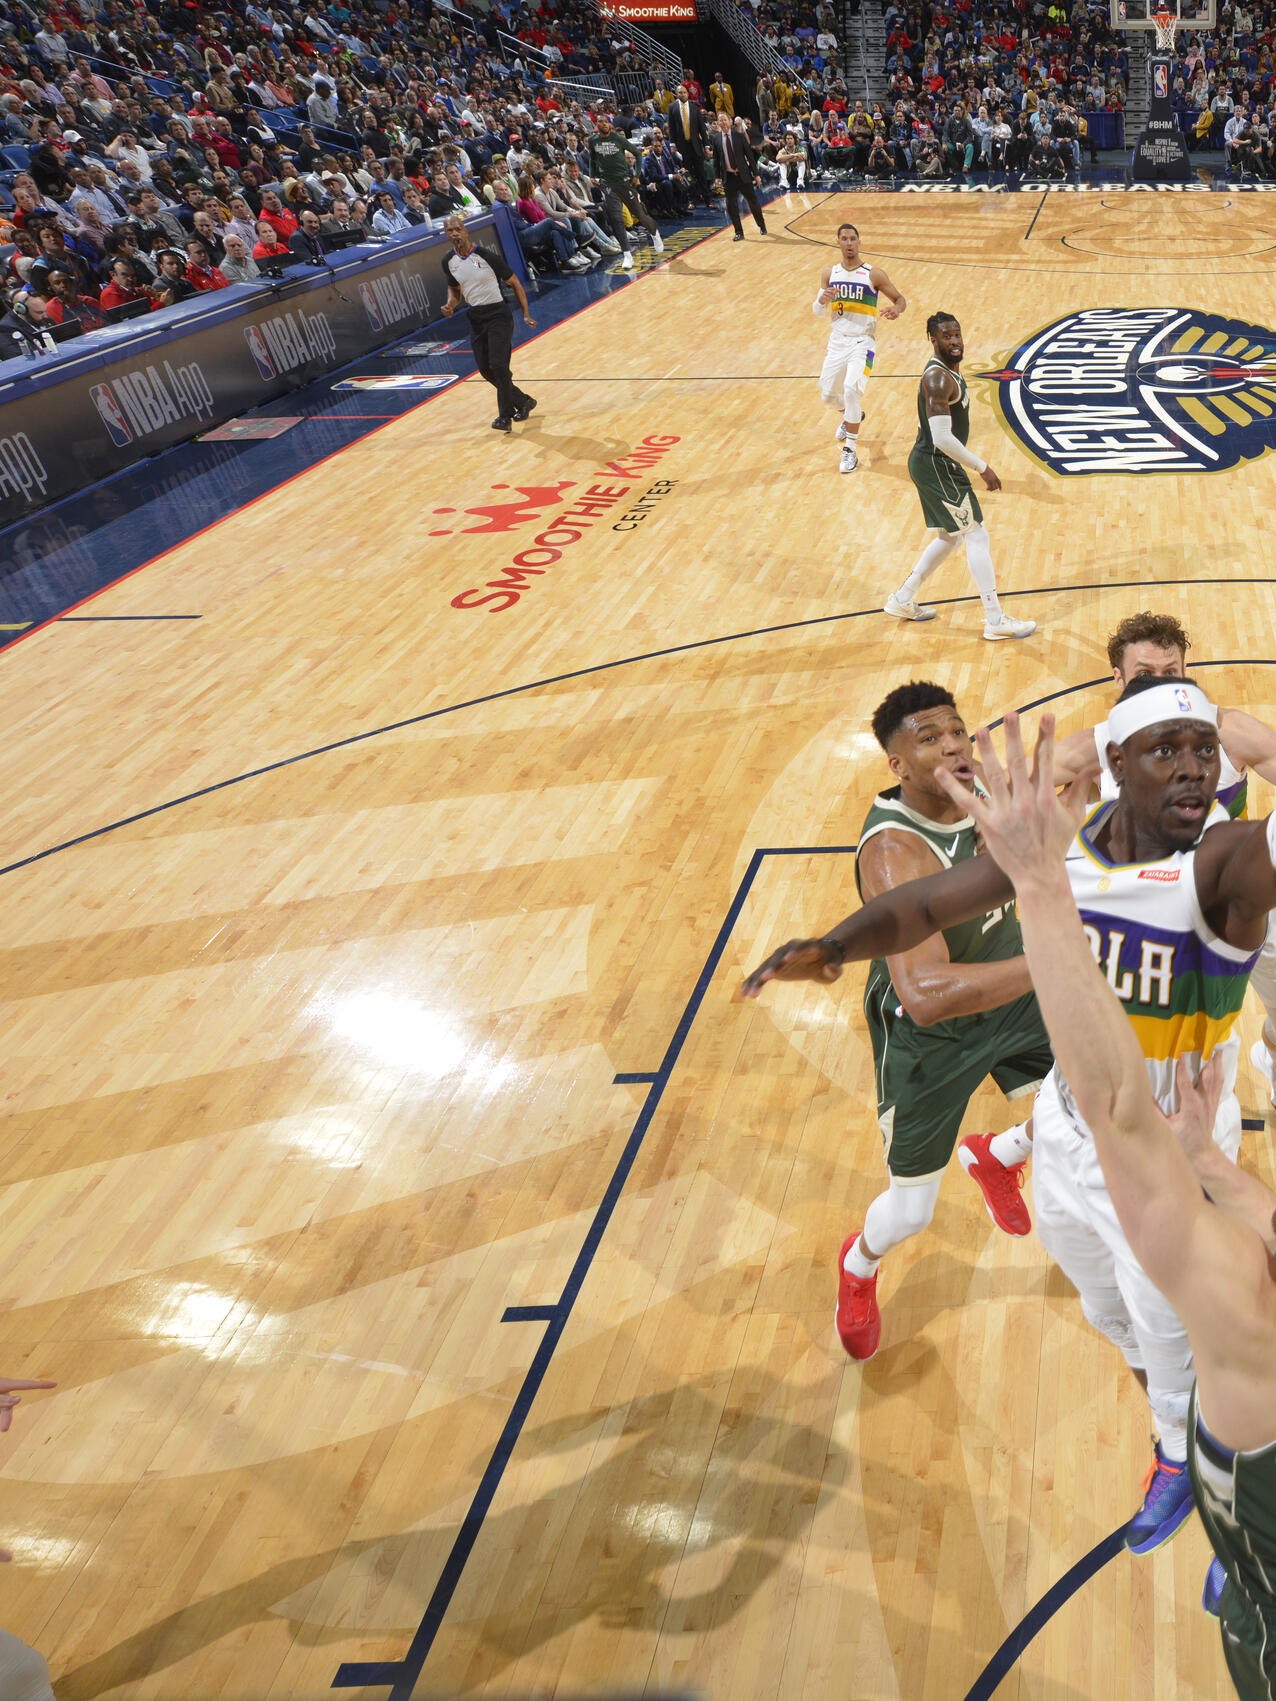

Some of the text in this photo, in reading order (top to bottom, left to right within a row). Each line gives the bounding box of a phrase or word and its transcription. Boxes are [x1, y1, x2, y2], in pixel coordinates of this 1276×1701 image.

[619, 5, 668, 16] SMOOTHIE
[1149, 121, 1172, 129] #BHM
[900, 183, 1008, 193] NEW
[1020, 183, 1212, 193] ORLEANS
[374, 269, 431, 326] NBA App
[263, 309, 337, 375] NBA App
[111, 360, 215, 439] NBA App
[1028, 308, 1208, 472] NEW ORLEANS
[612, 479, 679, 531] CENTER
[450, 484, 631, 613] SMOOTHIE
